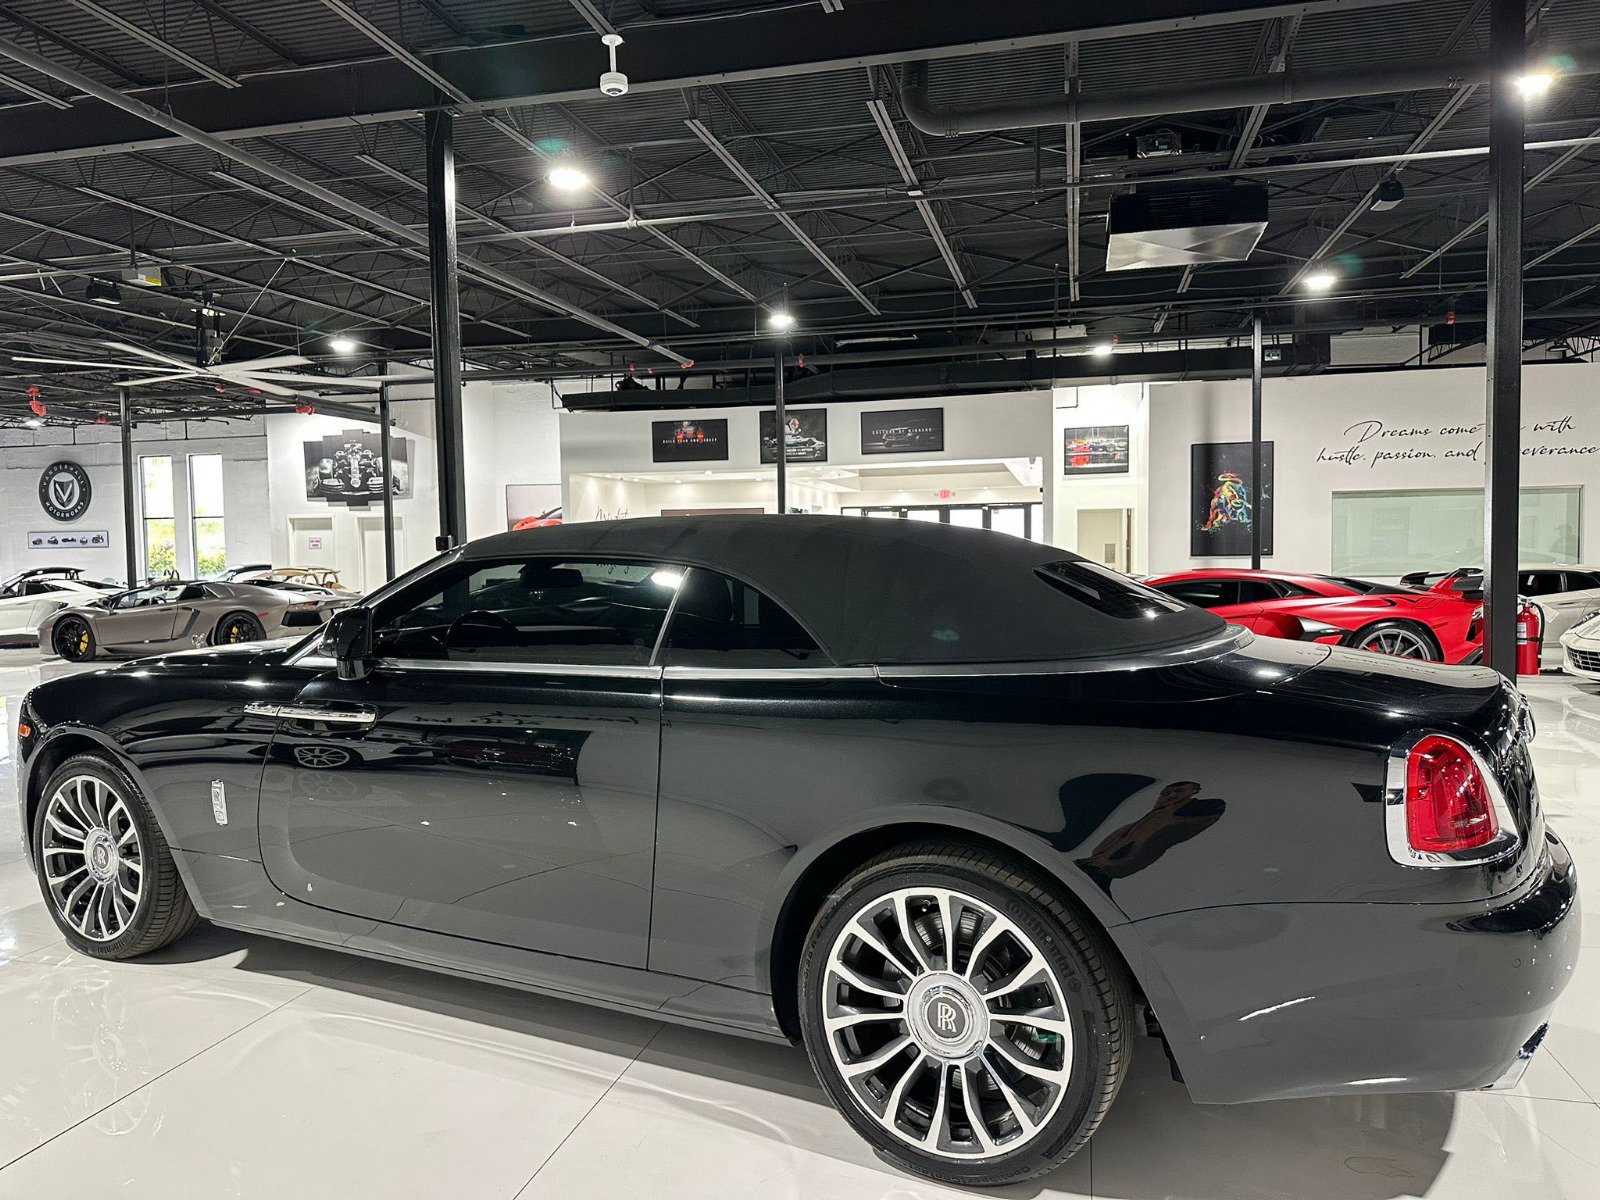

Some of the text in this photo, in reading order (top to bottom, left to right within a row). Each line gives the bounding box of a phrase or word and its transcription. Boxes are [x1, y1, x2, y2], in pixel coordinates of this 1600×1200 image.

[1343, 420, 1432, 443] Dreams
[1440, 426, 1482, 435] come
[1533, 416, 1577, 433] with
[1444, 441, 1483, 460] and
[1519, 446, 1600, 456] everance
[43, 464, 85, 486] VANDERHALL
[46, 501, 84, 518] MOTORWORKS
[937, 1002, 957, 1033] RR
